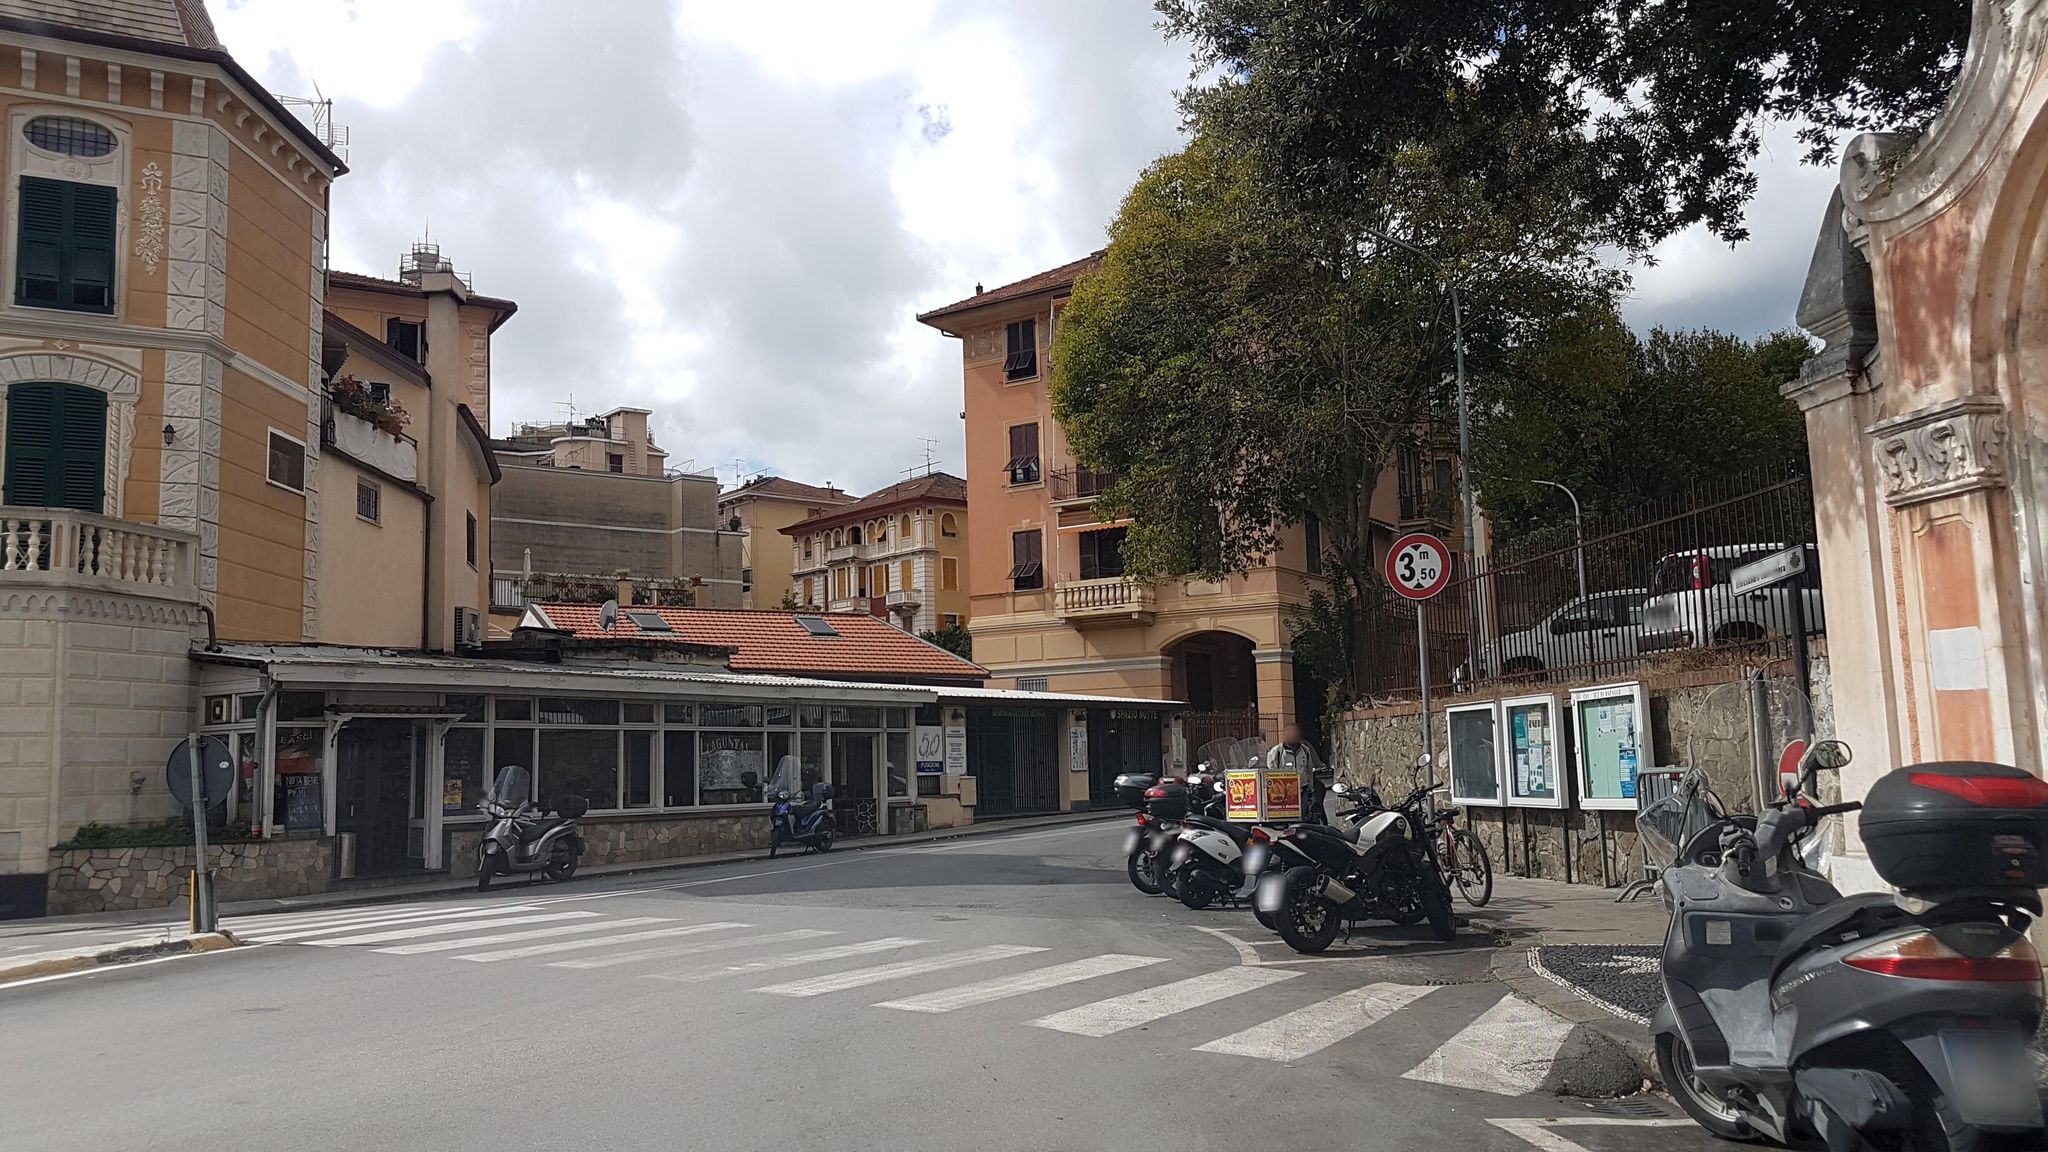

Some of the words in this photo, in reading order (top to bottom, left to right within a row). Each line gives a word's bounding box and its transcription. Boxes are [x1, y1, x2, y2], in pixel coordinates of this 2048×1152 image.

[1419, 551, 1429, 560] m
[1117, 710, 1138, 719] SPAZIO
[1138, 711, 1158, 720] NOTTE
